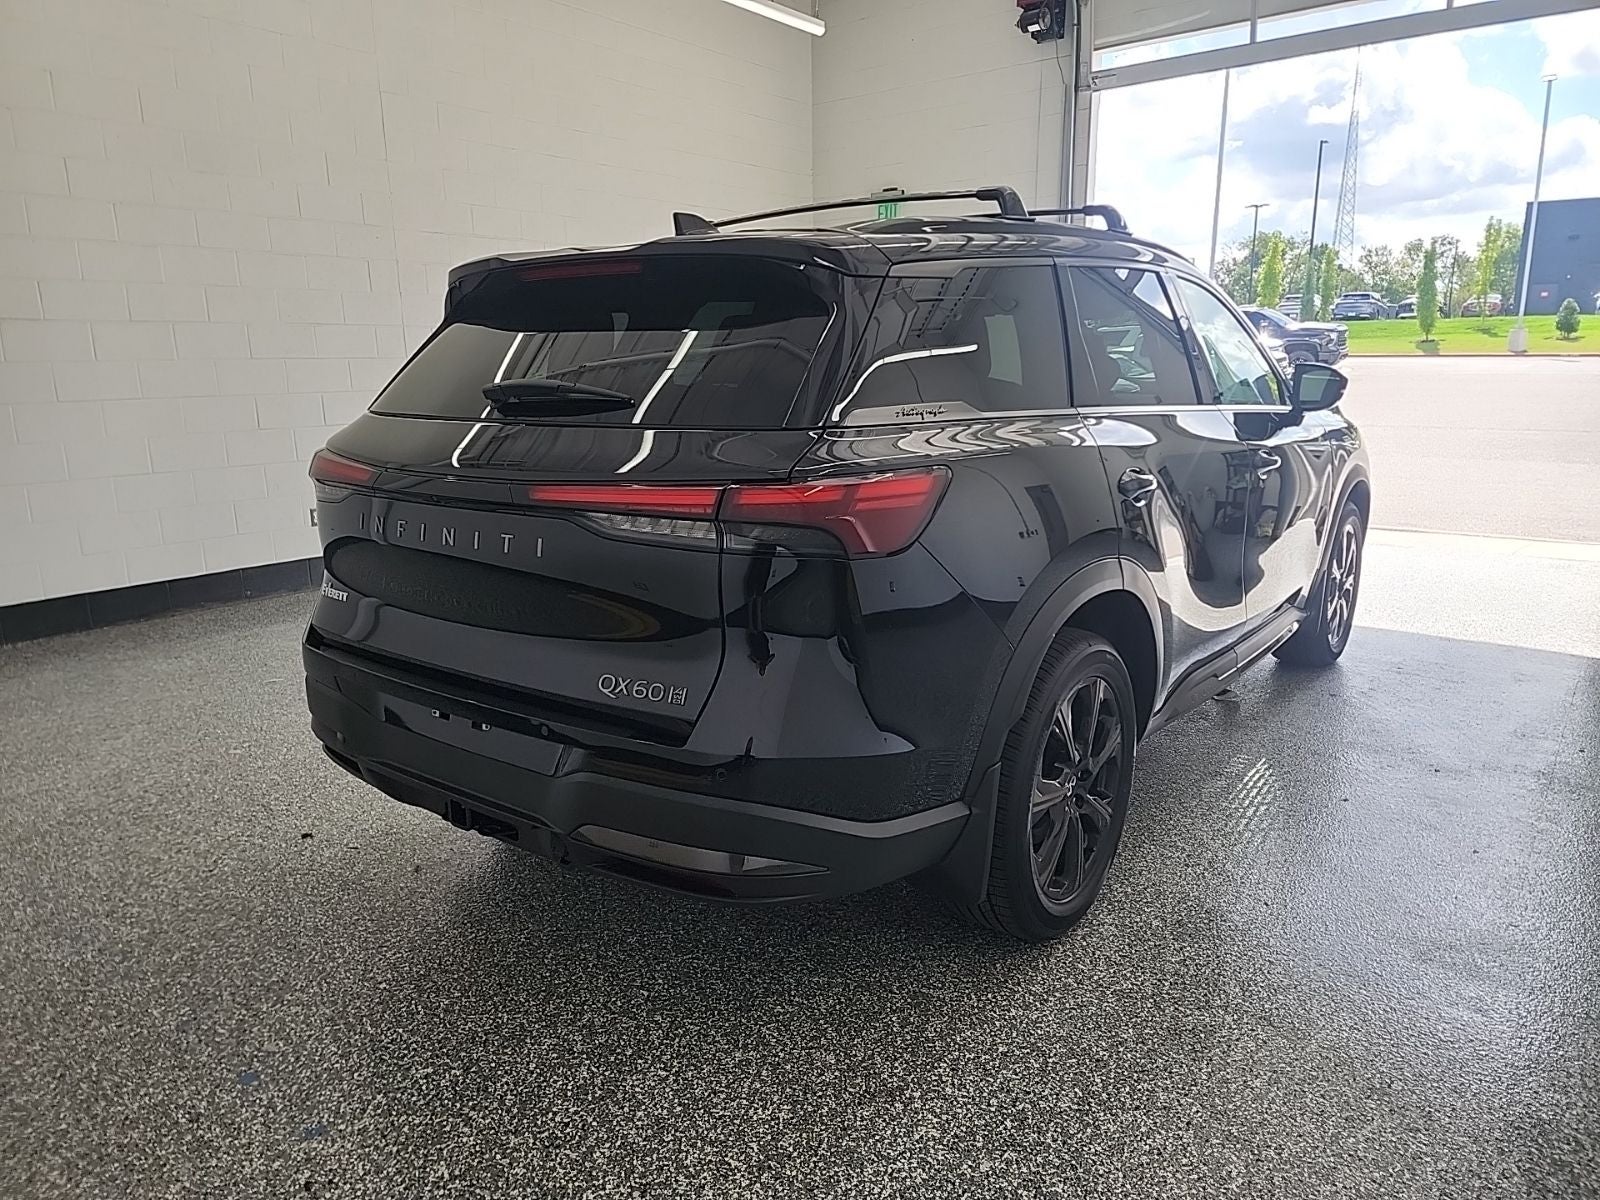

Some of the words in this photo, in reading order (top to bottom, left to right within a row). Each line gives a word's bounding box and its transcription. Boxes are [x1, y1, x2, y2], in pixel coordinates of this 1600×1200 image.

[878, 203, 899, 219] EXIT
[359, 512, 543, 557] INFINITI
[598, 674, 665, 701] QX60
